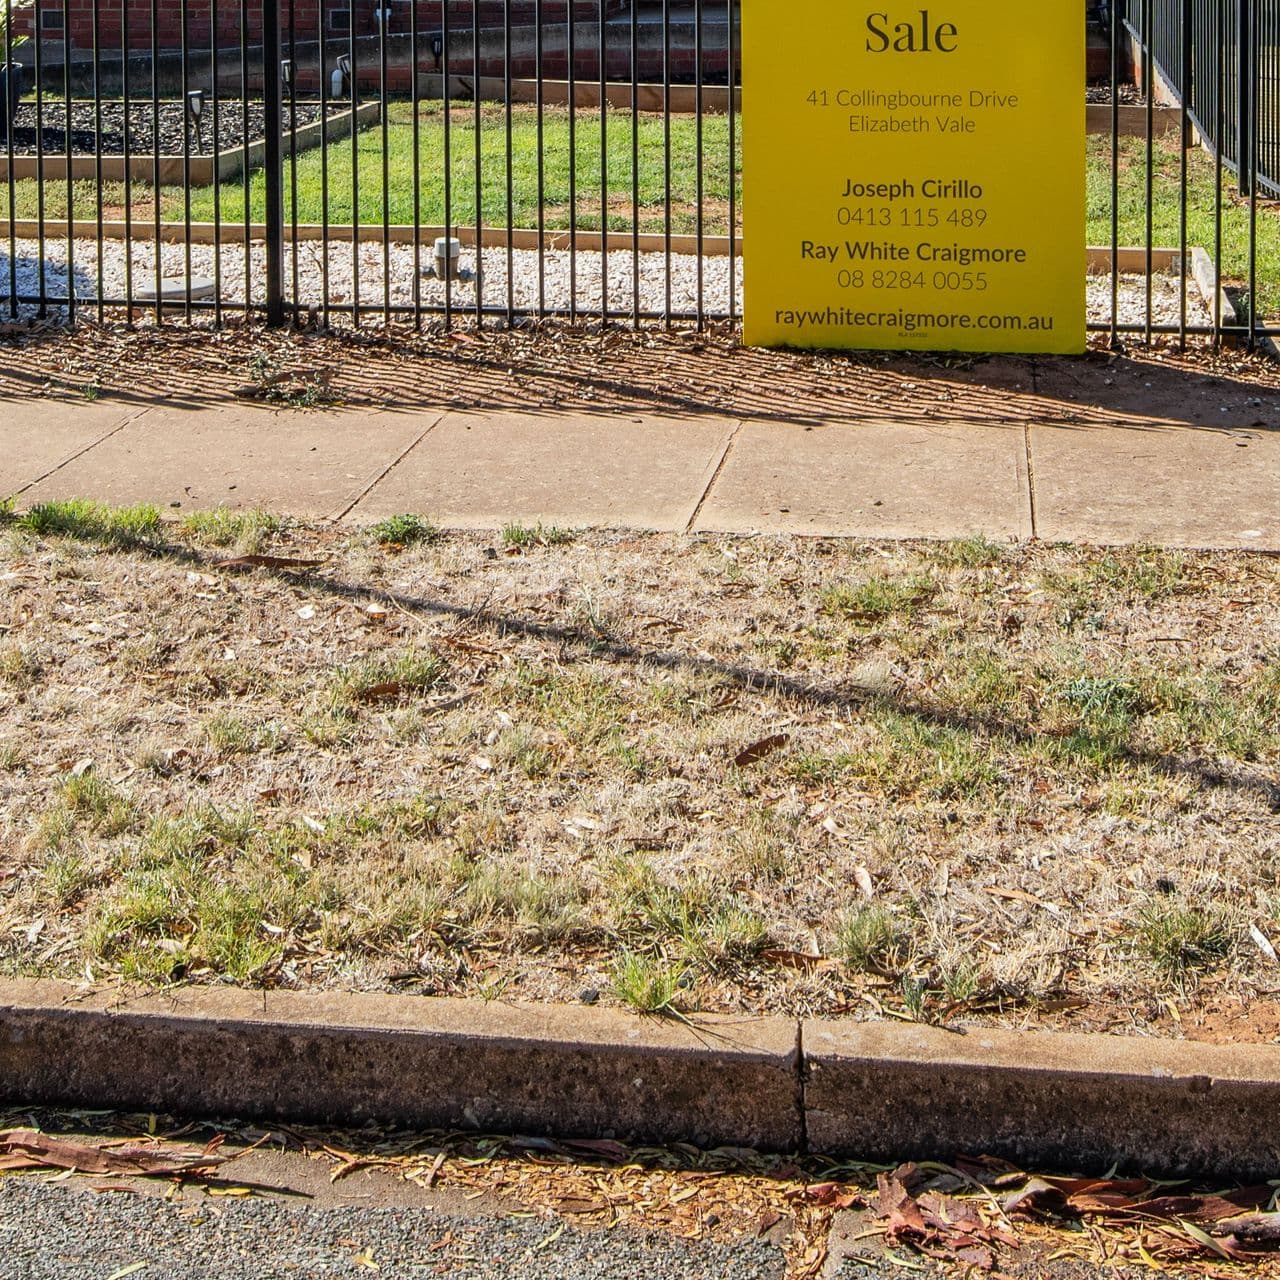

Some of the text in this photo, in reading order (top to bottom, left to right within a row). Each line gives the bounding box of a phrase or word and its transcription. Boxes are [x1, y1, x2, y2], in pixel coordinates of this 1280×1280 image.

[865, 10, 959, 53] Sale
[806, 89, 1019, 110] 41 Collingbourne Drive
[849, 115, 976, 133] Elizabeth Vale
[841, 179, 983, 202] Joseph Cirillo
[837, 207, 988, 228] 0413 115 489
[801, 240, 1027, 266] Ray White Craigmore
[837, 269, 988, 291] 08 8284 0055
[775, 305, 1053, 331] raywhitecraigmore.com.au
